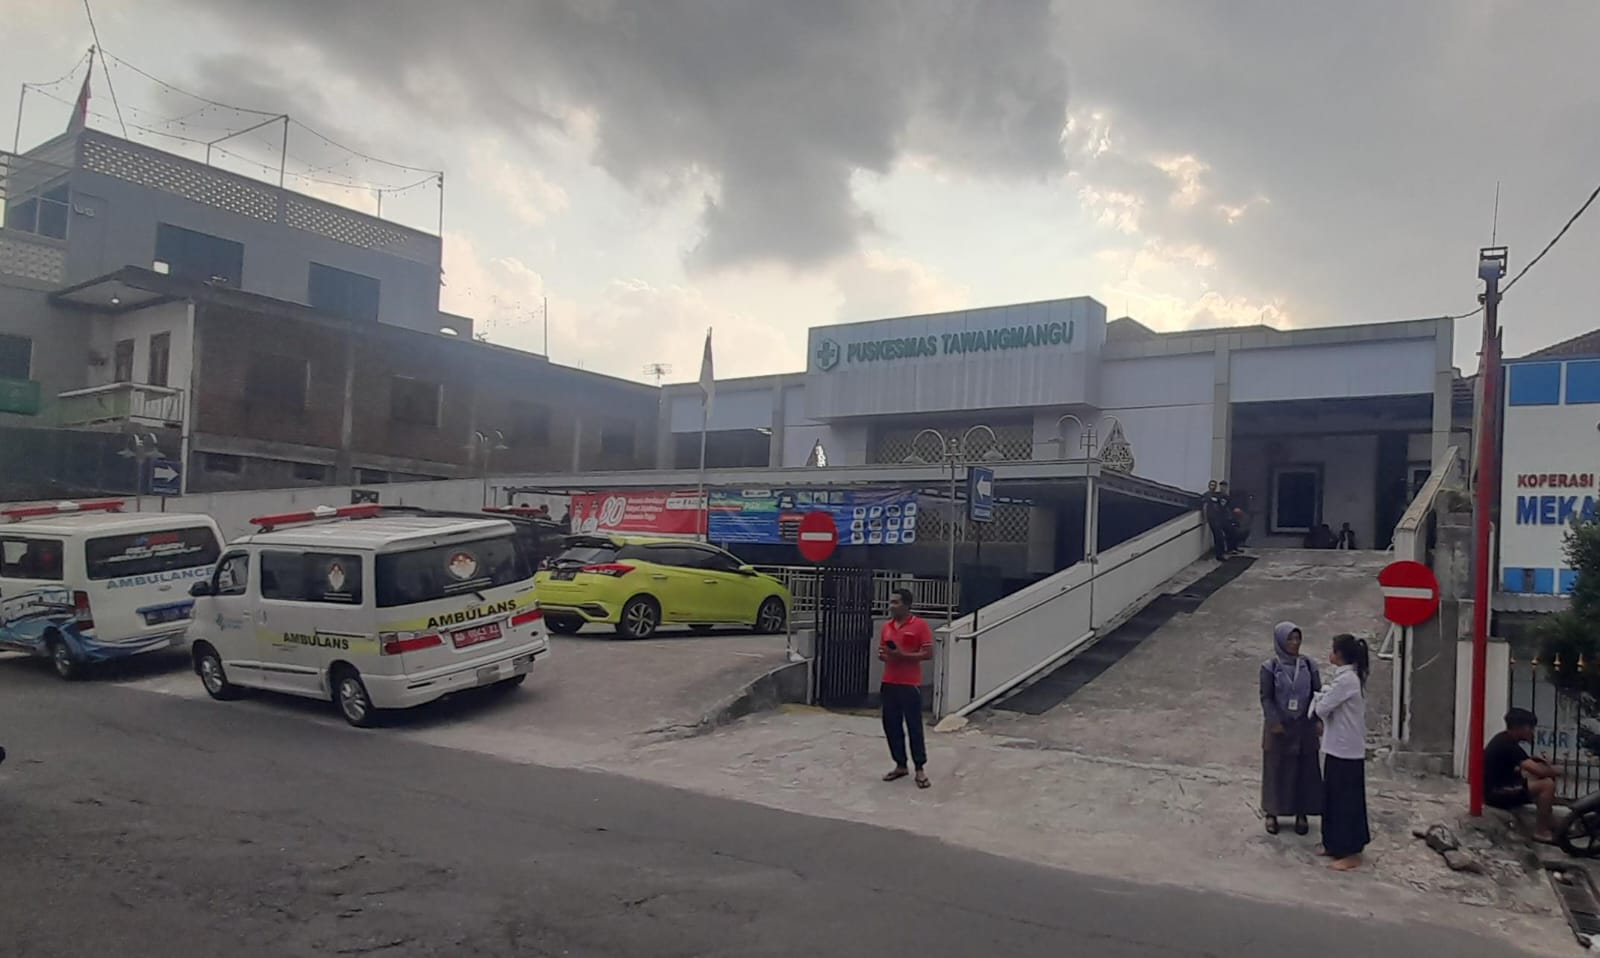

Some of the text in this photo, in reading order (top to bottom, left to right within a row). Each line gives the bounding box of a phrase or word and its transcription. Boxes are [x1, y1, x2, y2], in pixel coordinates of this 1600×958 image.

[847, 321, 1074, 362] PUSKESMAS TAWANGMANGU
[1517, 473, 1594, 488] KOPERASI
[426, 599, 517, 629] AMBULANS
[283, 632, 350, 650] AMBULANS
